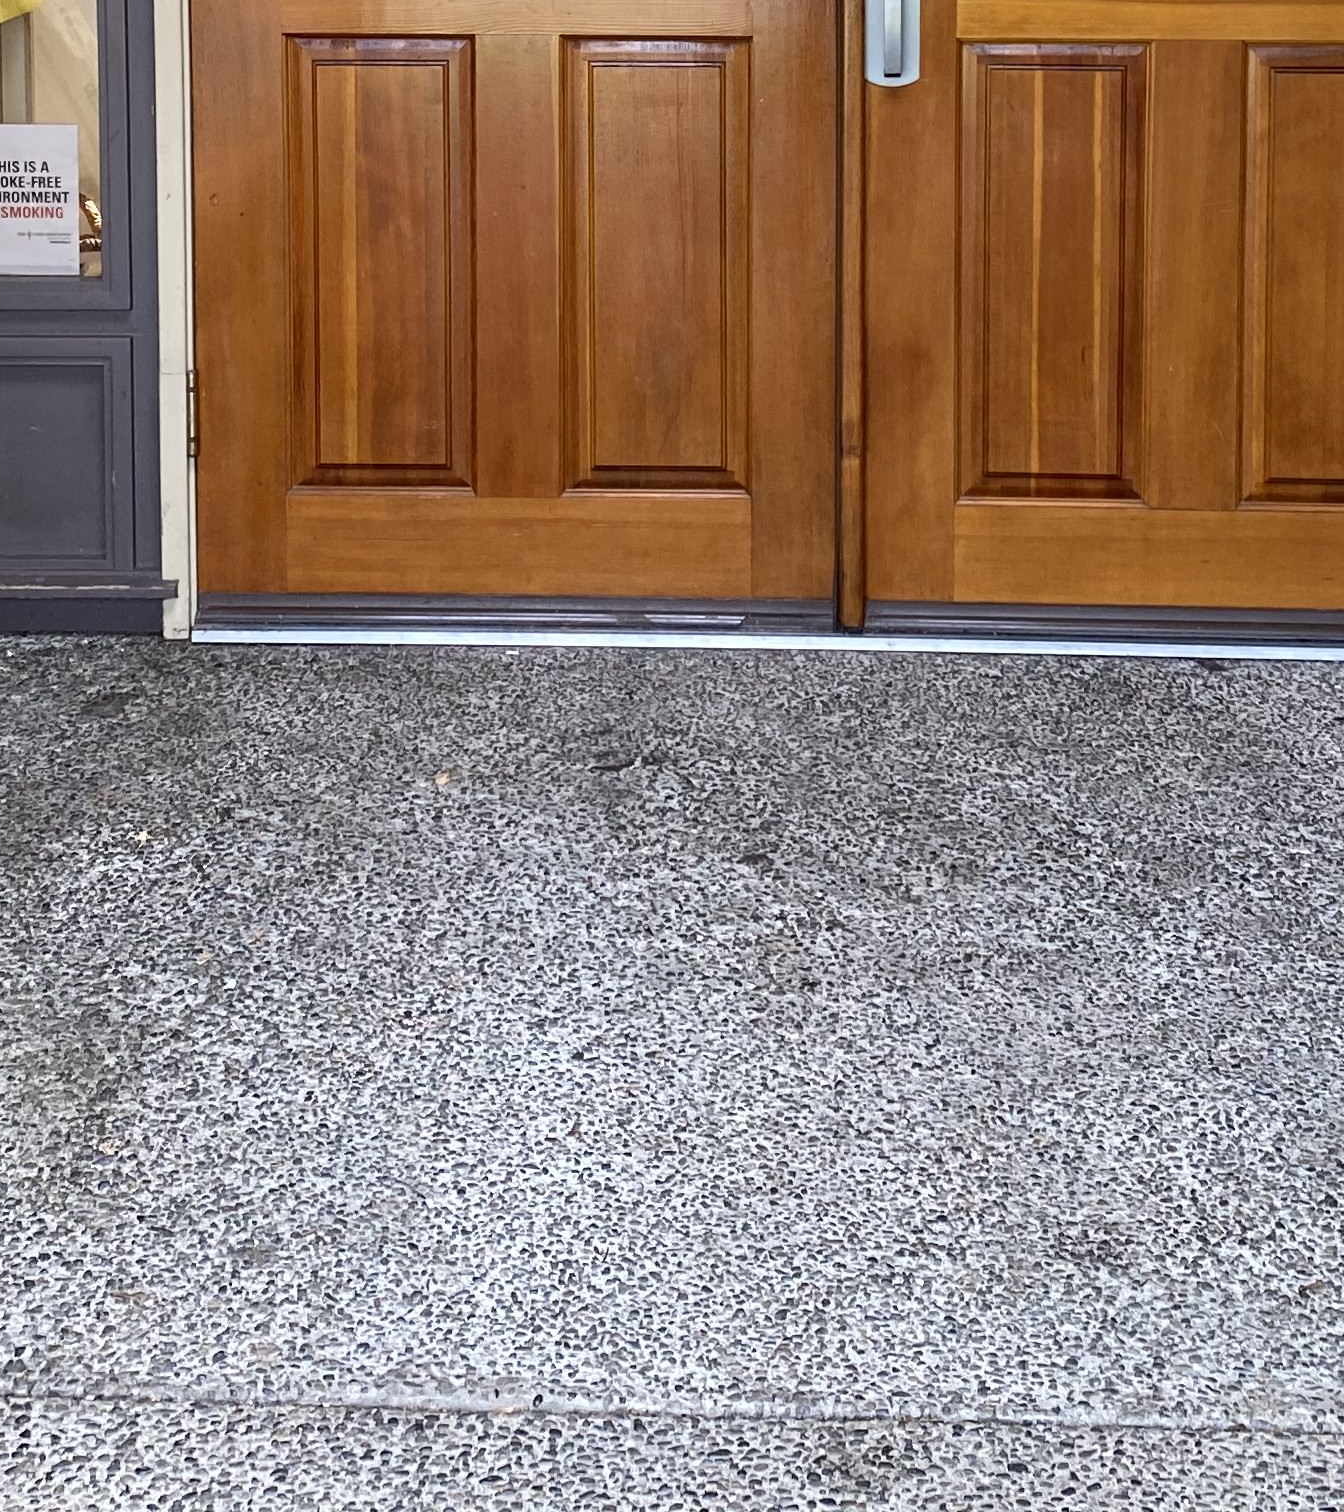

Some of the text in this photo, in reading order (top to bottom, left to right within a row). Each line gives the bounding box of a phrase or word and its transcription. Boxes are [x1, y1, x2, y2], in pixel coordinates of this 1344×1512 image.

[24, 161, 36, 173] IS
[40, 161, 49, 173] A
[1, 206, 64, 219] SMOKING
